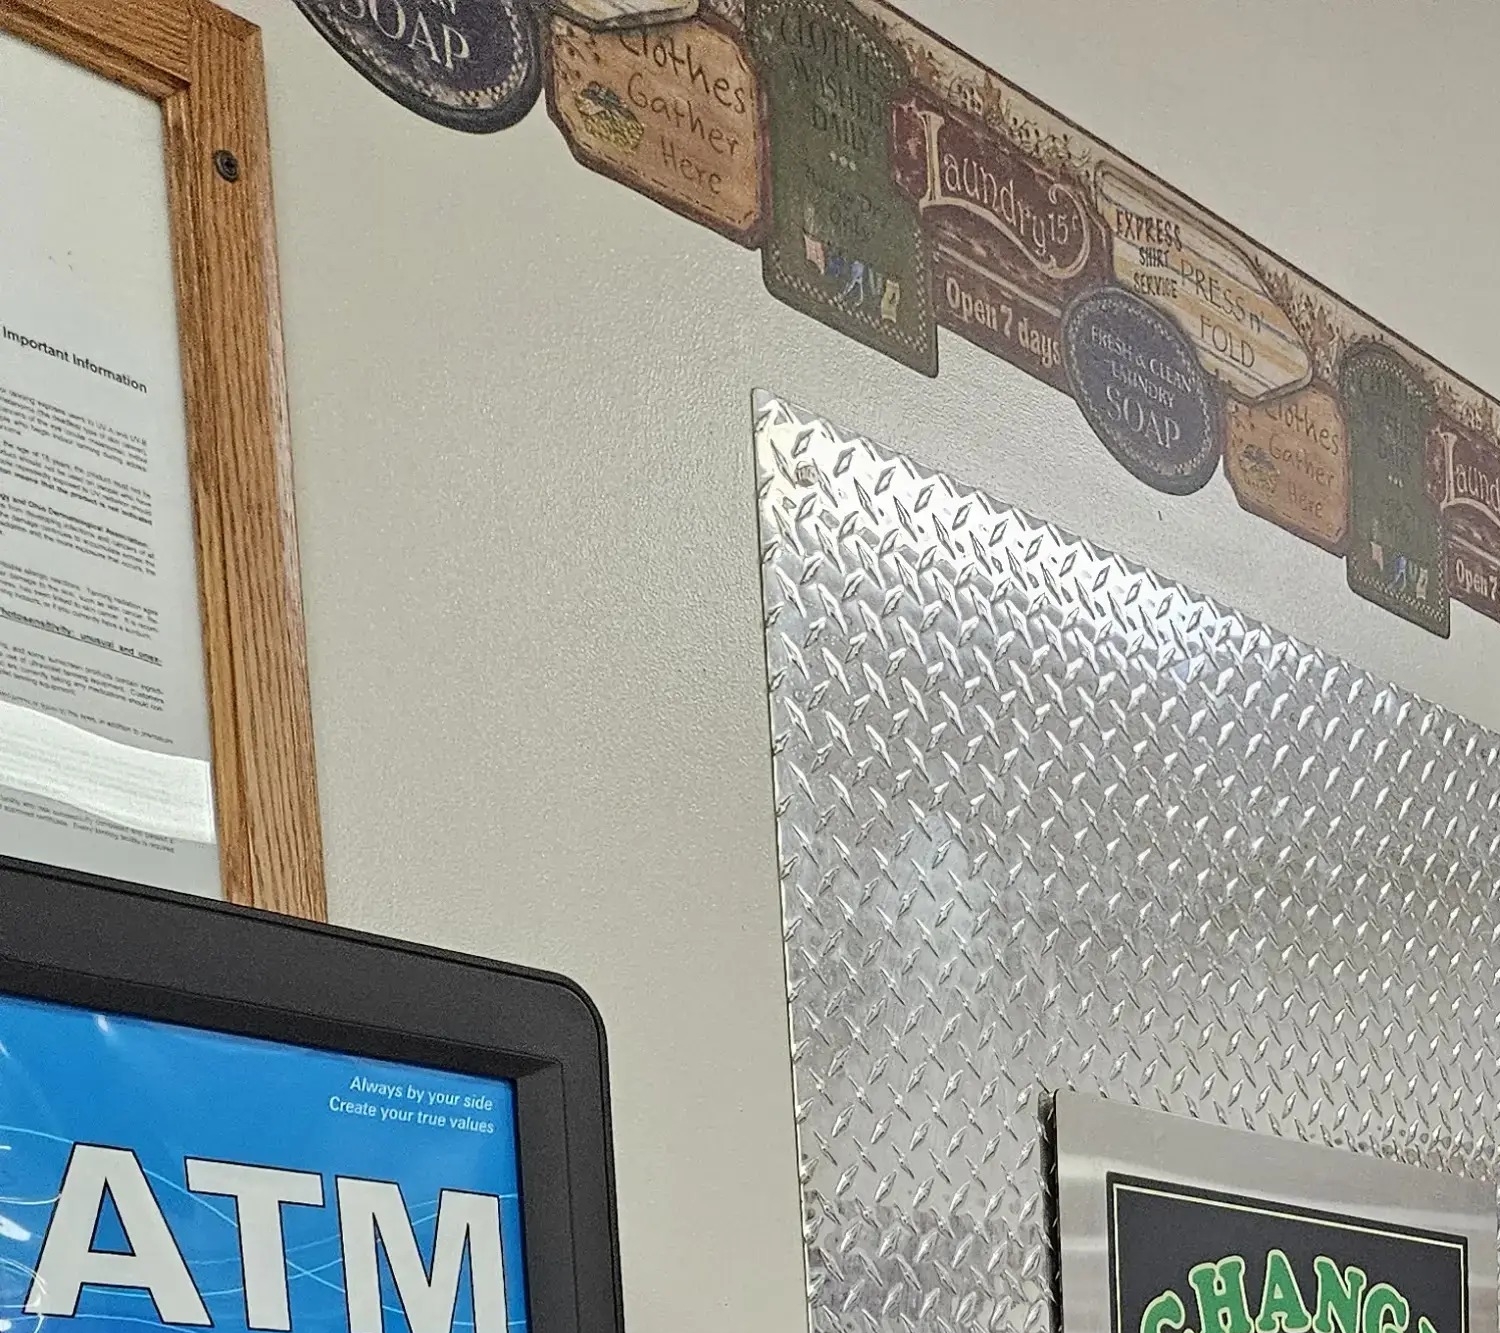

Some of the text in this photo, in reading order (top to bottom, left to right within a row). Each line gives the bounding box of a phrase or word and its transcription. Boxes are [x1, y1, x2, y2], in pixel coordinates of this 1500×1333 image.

[627, 72, 738, 158] Gather
[660, 138, 724, 196] Here
[917, 110, 1062, 258] Laundry
[1115, 208, 1184, 253] EXPRESS
[1138, 246, 1171, 269] SHIRT
[1132, 269, 1180, 301] SERVICE
[1180, 257, 1249, 322] PRESS
[945, 275, 1062, 370] Open 7 days
[1199, 314, 1257, 370] FOLD
[2, 326, 149, 394] Important Information
[1105, 383, 1182, 450] SOAP
[1455, 557, 1489, 596] Open
[329, 1095, 495, 1134] Create your true values
[350, 1075, 494, 1112] Always by your side
